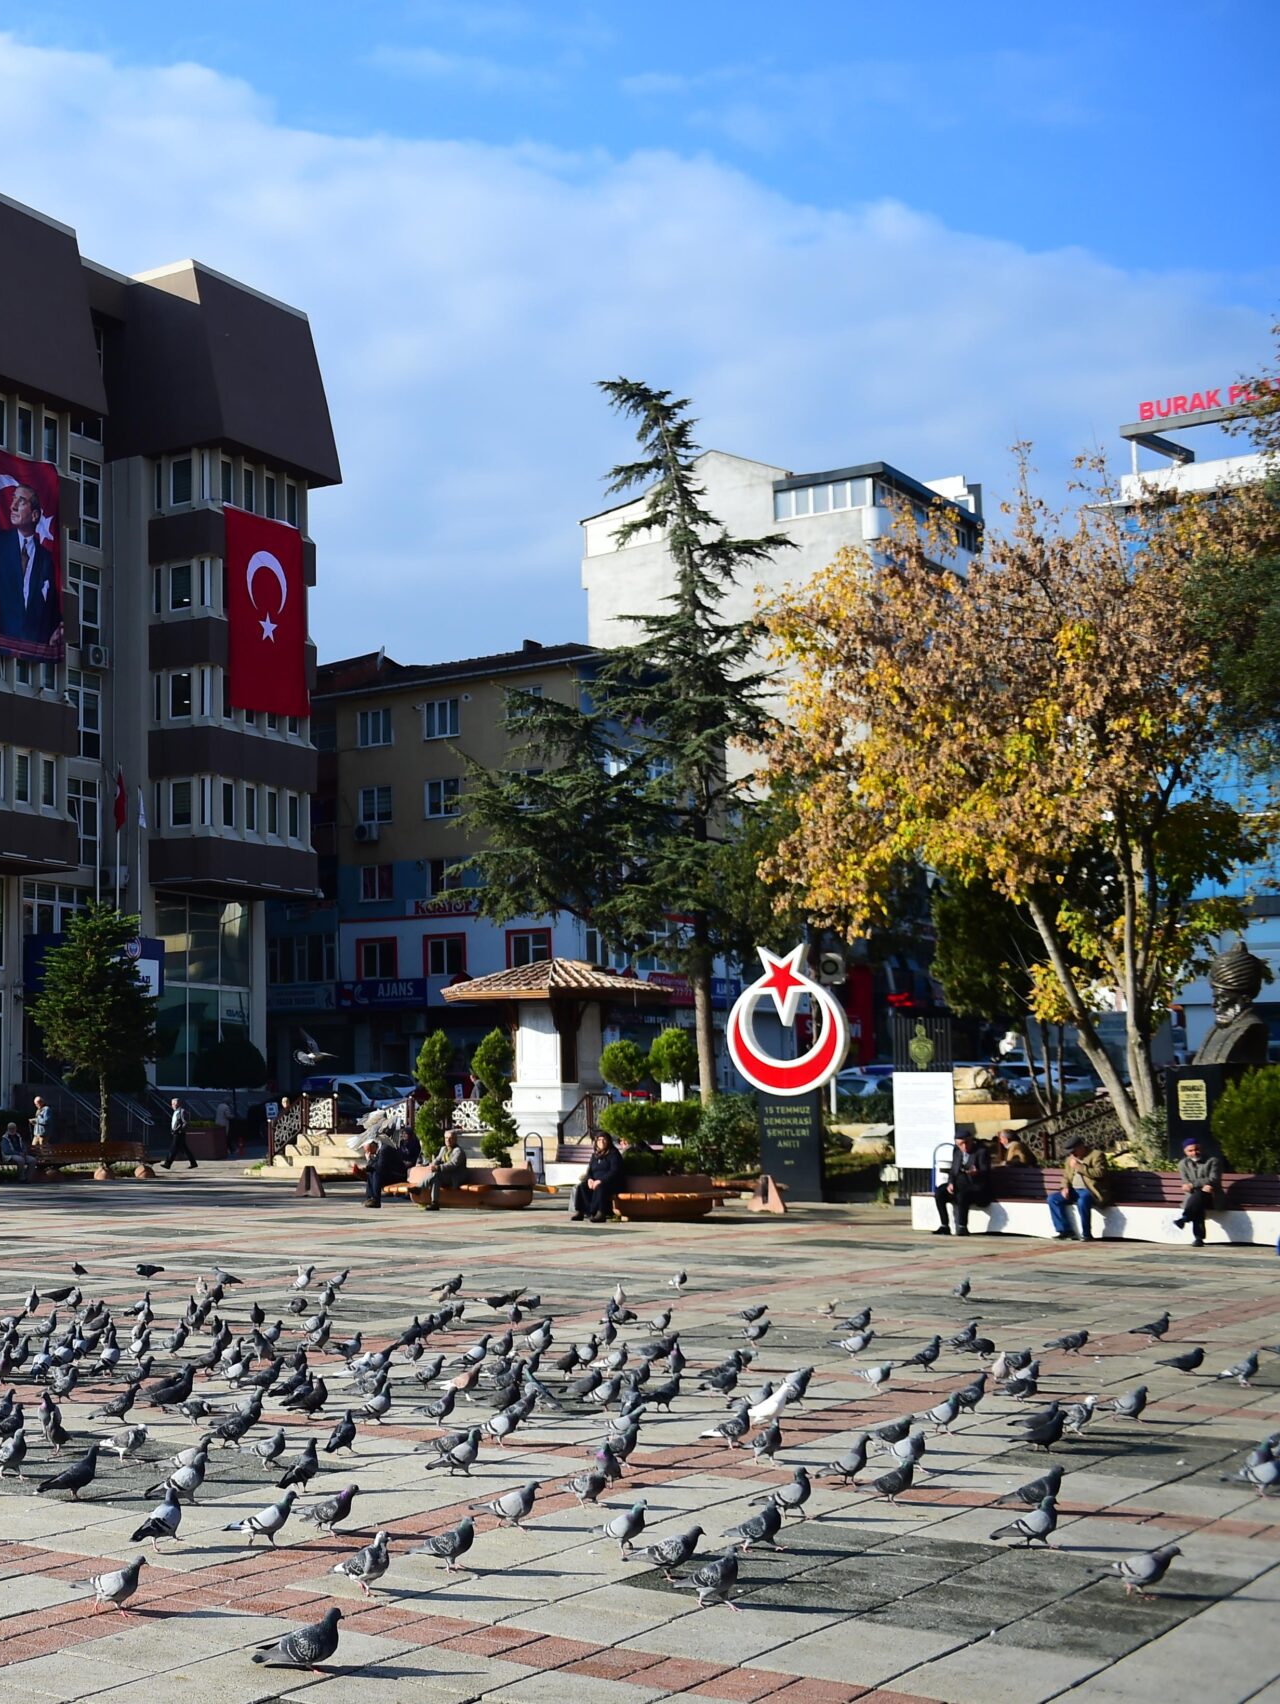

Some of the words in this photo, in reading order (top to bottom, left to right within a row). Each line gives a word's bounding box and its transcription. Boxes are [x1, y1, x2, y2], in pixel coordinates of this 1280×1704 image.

[1139, 388, 1222, 421] BURAK
[377, 981, 415, 998] AJANS
[764, 1105, 775, 1114] 15
[776, 1105, 811, 1114] TEMMUZ
[763, 1116, 812, 1126] DEMOKRASİ
[777, 1140, 800, 1149] ANITI
